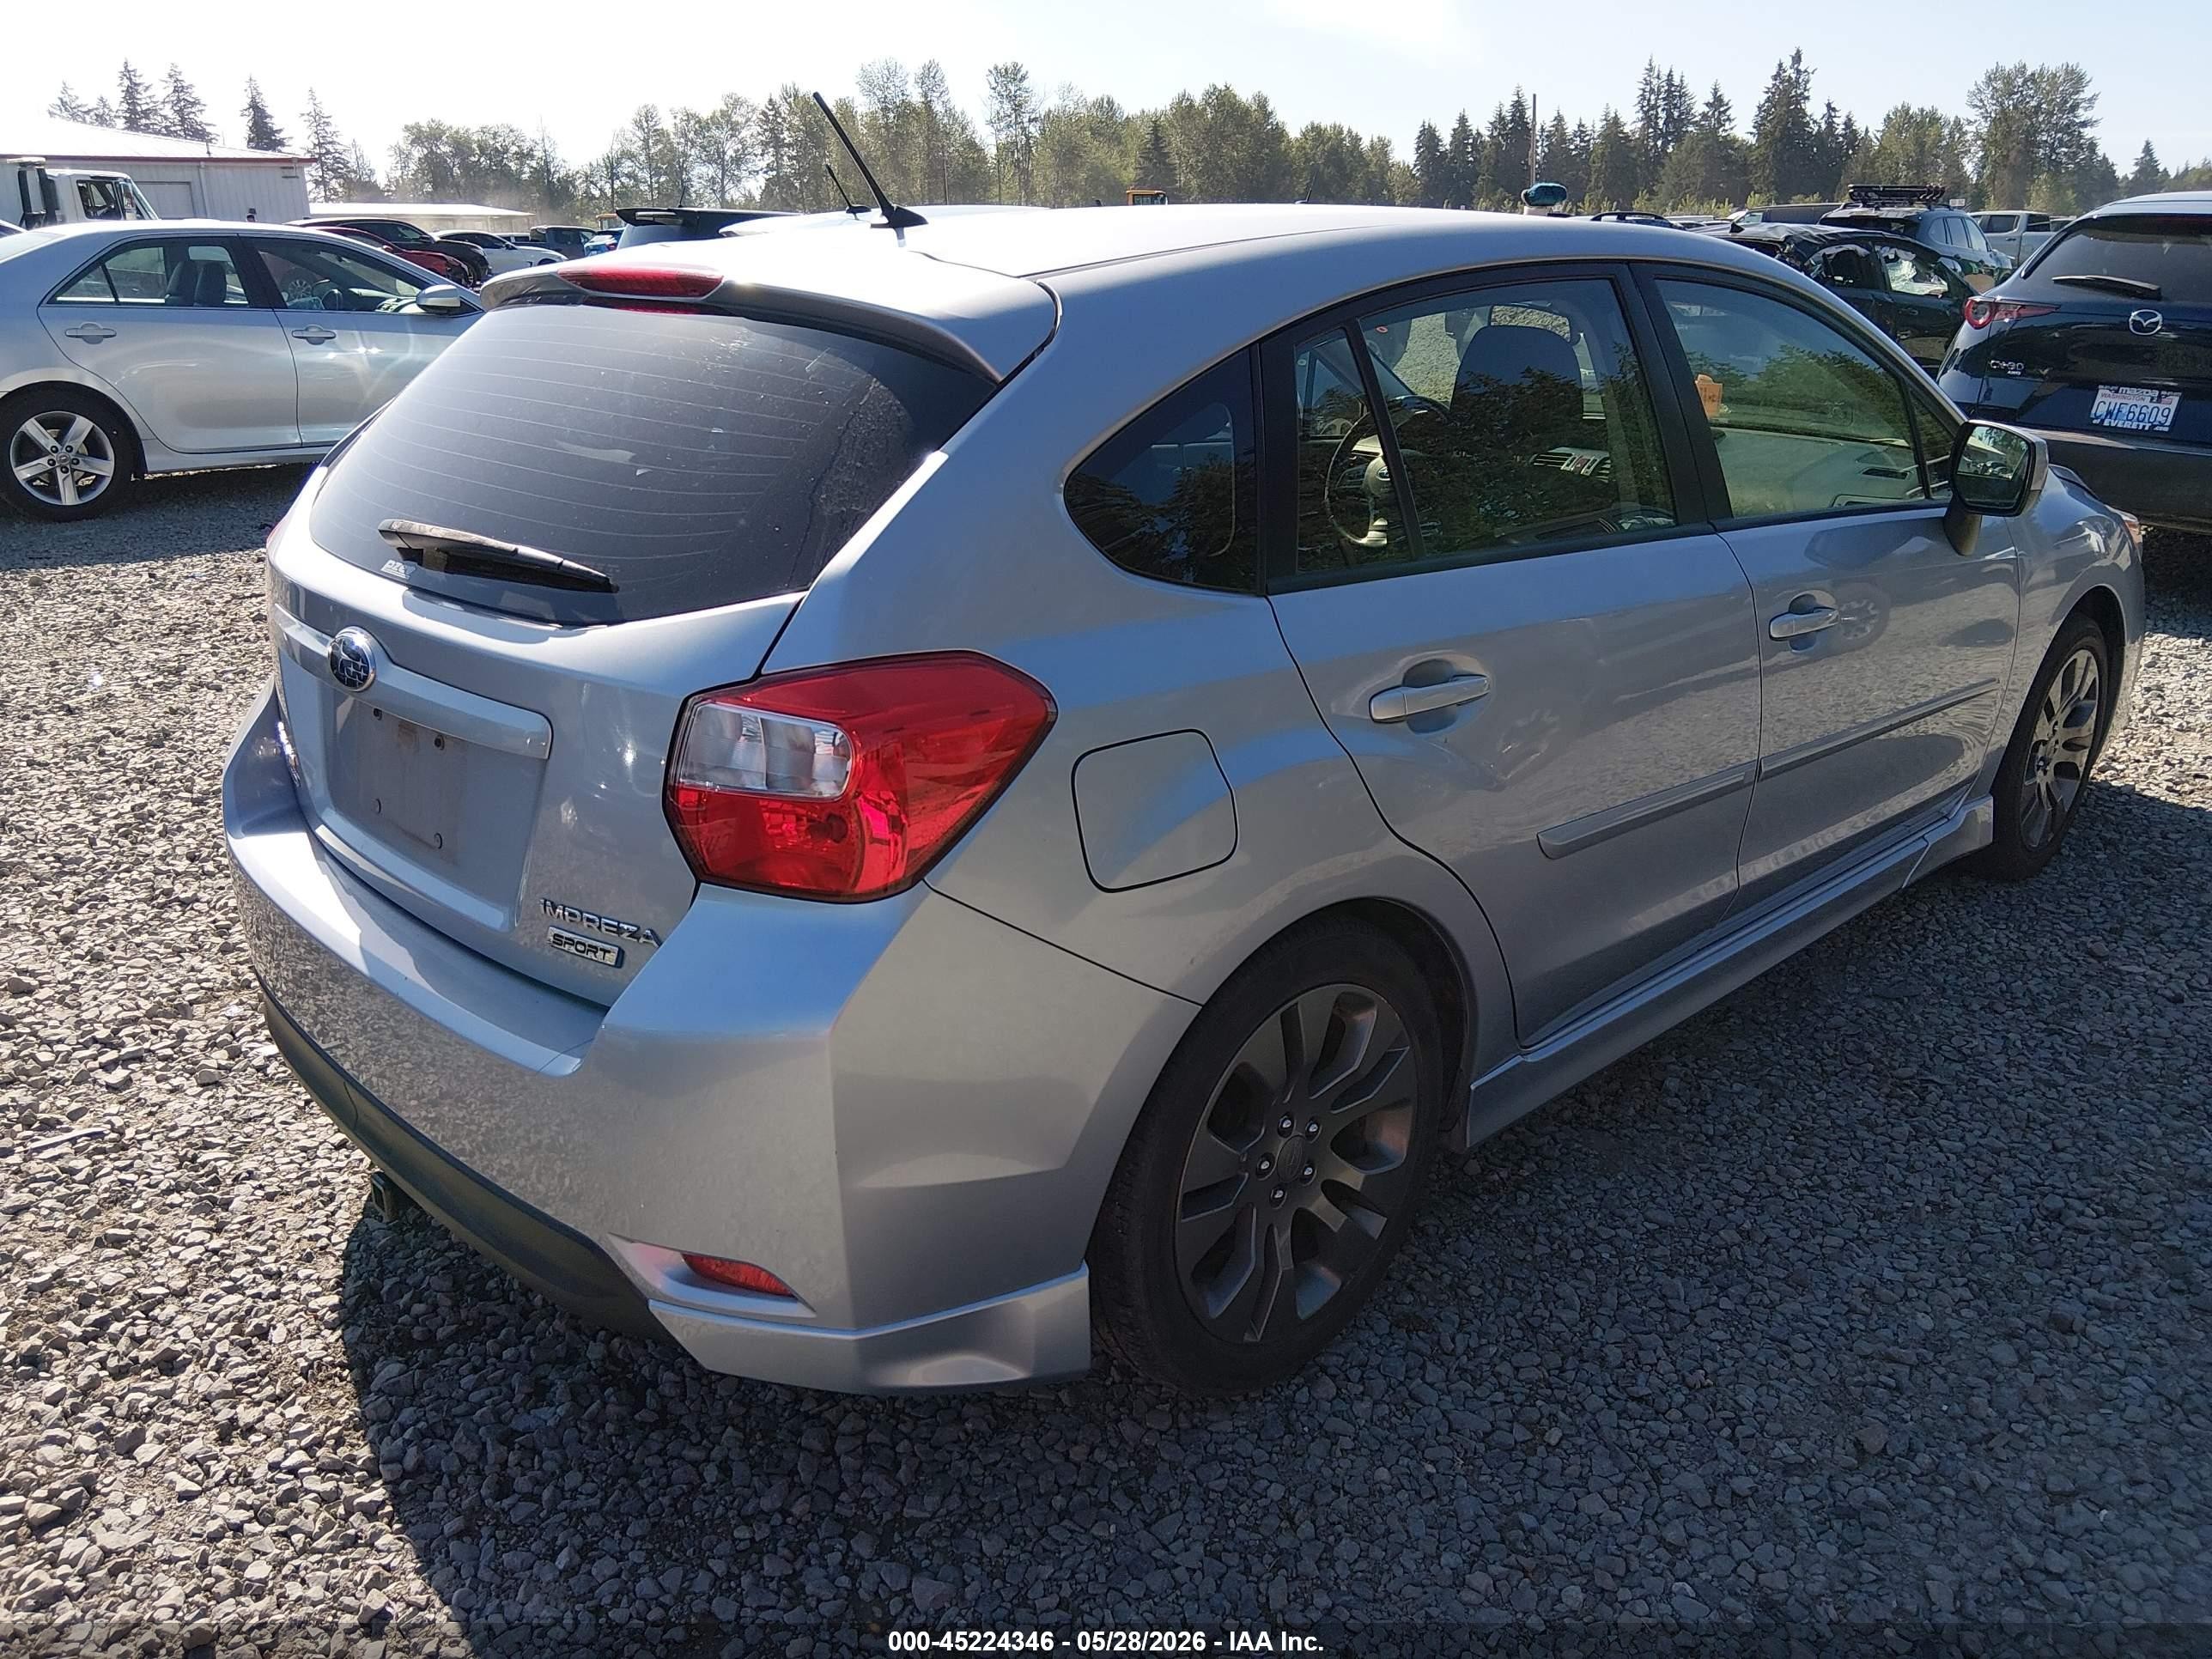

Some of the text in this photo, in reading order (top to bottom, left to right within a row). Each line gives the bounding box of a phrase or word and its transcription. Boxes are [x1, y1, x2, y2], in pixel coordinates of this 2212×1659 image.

[2100, 392, 2146, 402] WASHINGTON
[2094, 400, 2172, 426] CWF6609
[2103, 418, 2153, 430] EVERETT
[539, 898, 662, 947] IMPREZA
[551, 933, 612, 962] SPORT
